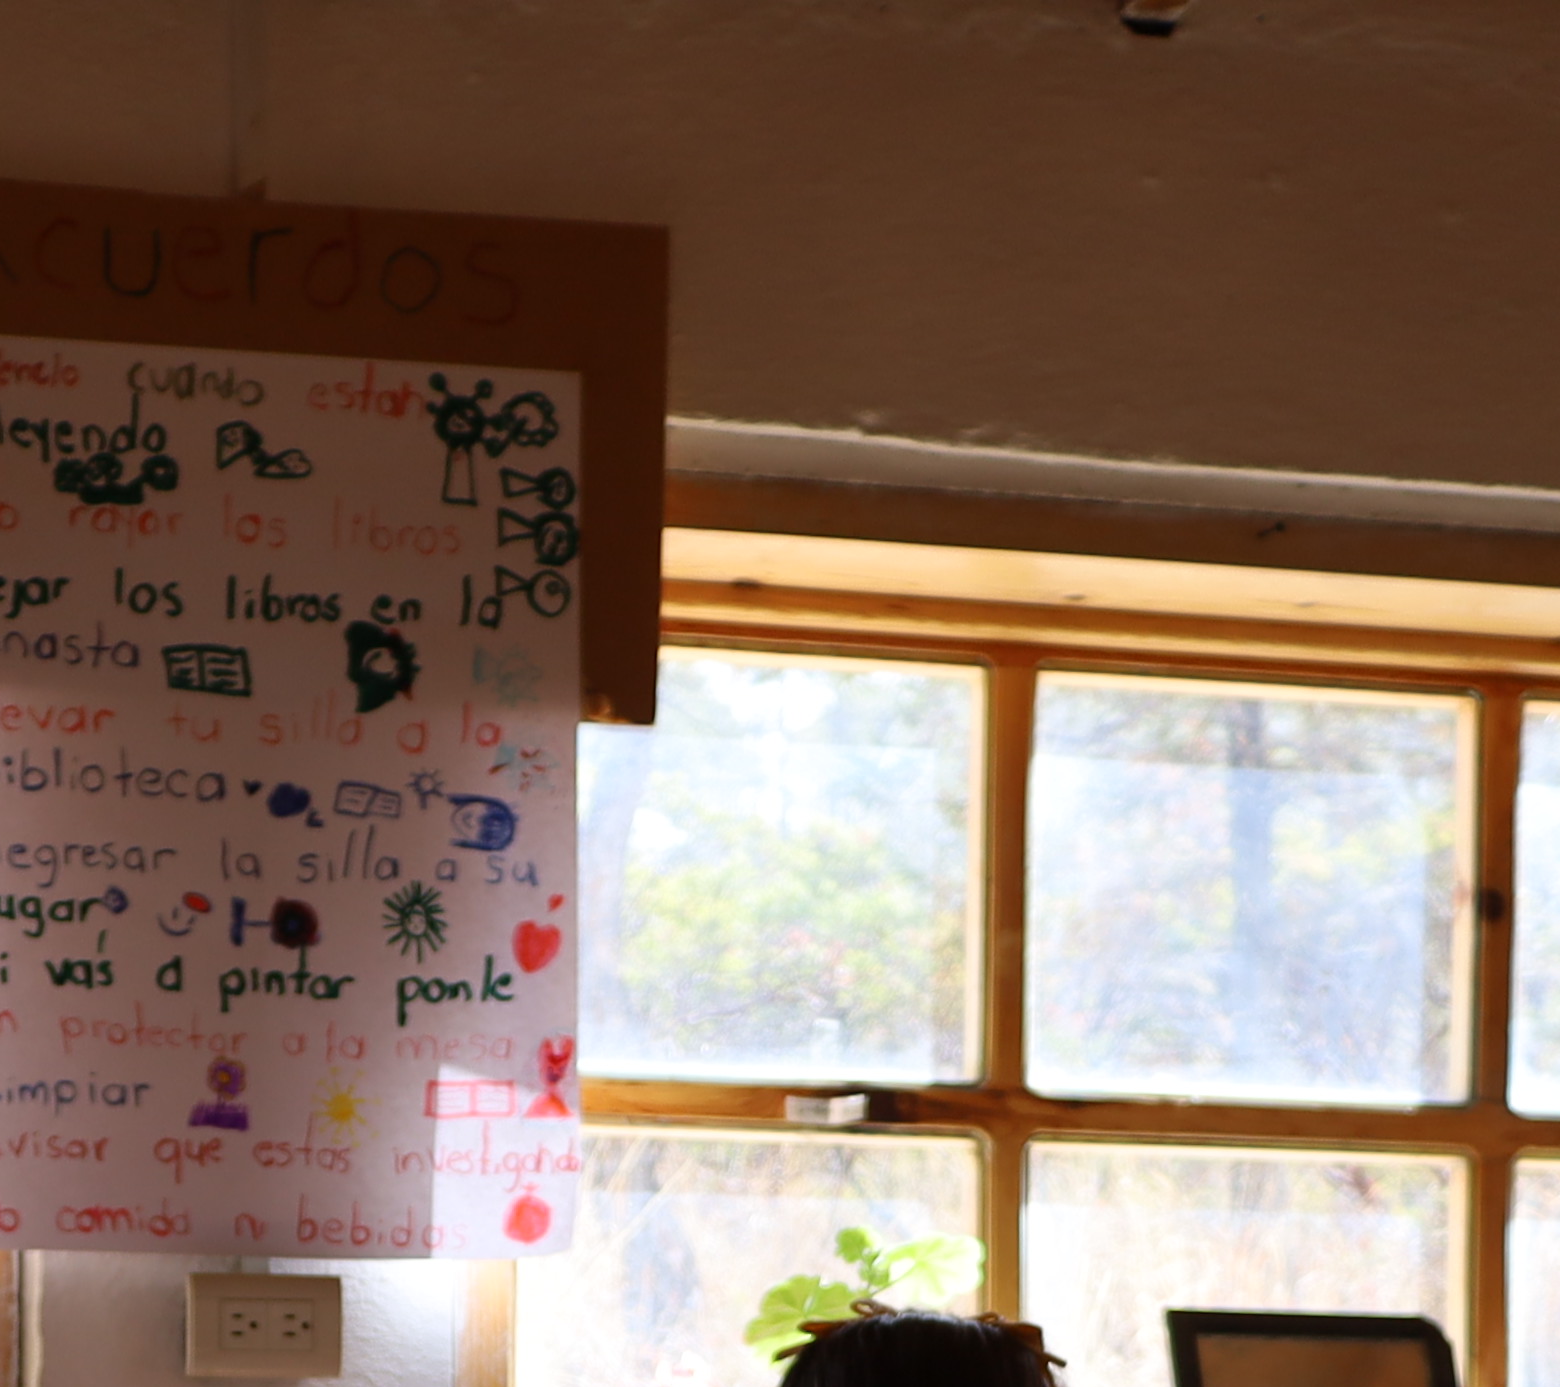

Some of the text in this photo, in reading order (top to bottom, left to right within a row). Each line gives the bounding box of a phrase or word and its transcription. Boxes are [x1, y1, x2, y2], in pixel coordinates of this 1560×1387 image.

[128, 362, 264, 406] cuando
[224, 494, 286, 547] los
[334, 497, 462, 555] libros
[114, 567, 183, 617] los
[226, 574, 340, 622] libros
[371, 595, 421, 624] en
[460, 574, 502, 629] la
[164, 701, 221, 742] tu
[259, 690, 362, 745] silla
[397, 721, 426, 753] a
[461, 701, 502, 747] la
[221, 838, 261, 881] la
[297, 825, 400, 883] silla
[435, 858, 457, 882] a
[484, 855, 538, 886] su
[156, 956, 182, 991] a
[219, 950, 355, 1013] pintar
[60, 1001, 248, 1053] protector
[282, 1032, 307, 1057] a
[324, 1019, 365, 1062] la
[396, 1033, 513, 1061] mesa
[153, 1137, 222, 1184] que
[252, 1112, 352, 1174] estas
[56, 1198, 191, 1237] comida
[296, 1193, 468, 1247] bebidas
